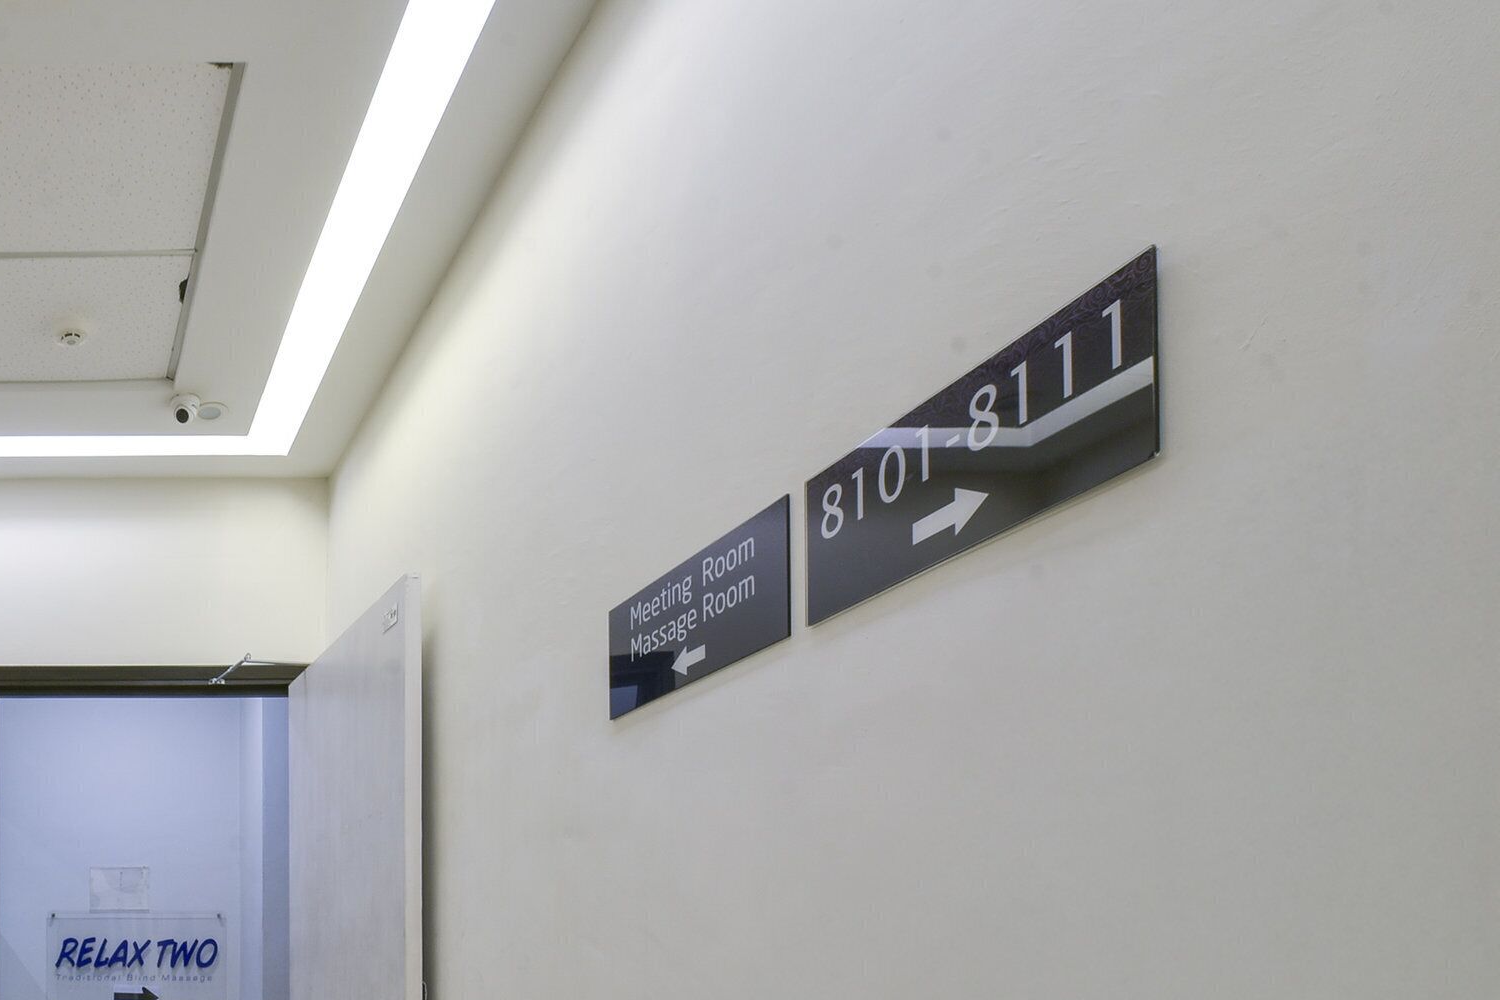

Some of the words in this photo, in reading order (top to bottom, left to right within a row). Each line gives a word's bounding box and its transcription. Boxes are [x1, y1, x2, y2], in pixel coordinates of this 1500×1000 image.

[821, 299, 1122, 538] 8101-8111
[630, 575, 693, 630] Meeting
[702, 537, 755, 586] Room
[630, 608, 698, 662] Massage
[702, 575, 755, 622] Room
[55, 937, 151, 968] RELAX
[157, 938, 218, 969] TWO
[56, 973, 122, 982] Traditional
[126, 973, 156, 982] Blind
[161, 973, 213, 983] Massage
